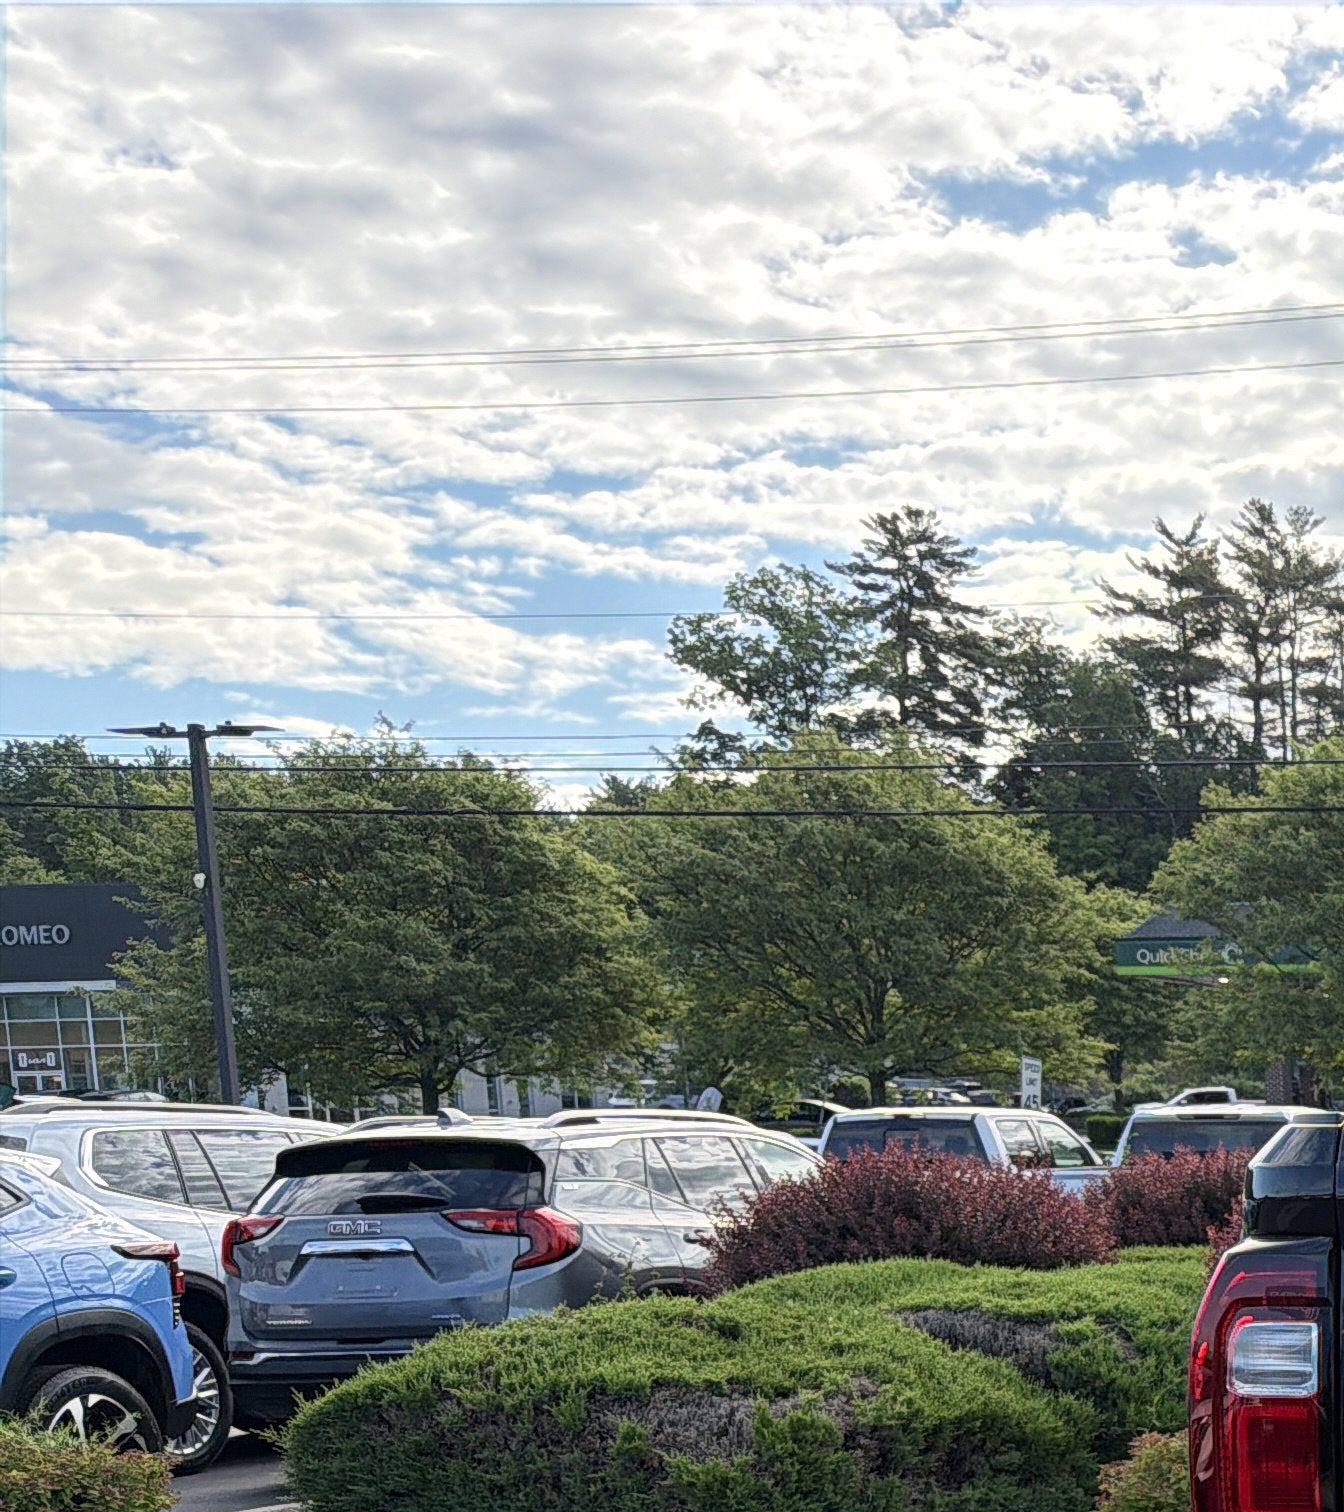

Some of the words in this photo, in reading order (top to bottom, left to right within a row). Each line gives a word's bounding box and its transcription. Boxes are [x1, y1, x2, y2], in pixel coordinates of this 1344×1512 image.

[0, 924, 70, 946] OMEO
[1024, 1094, 1039, 1110] 45
[328, 1220, 381, 1235] GMC
